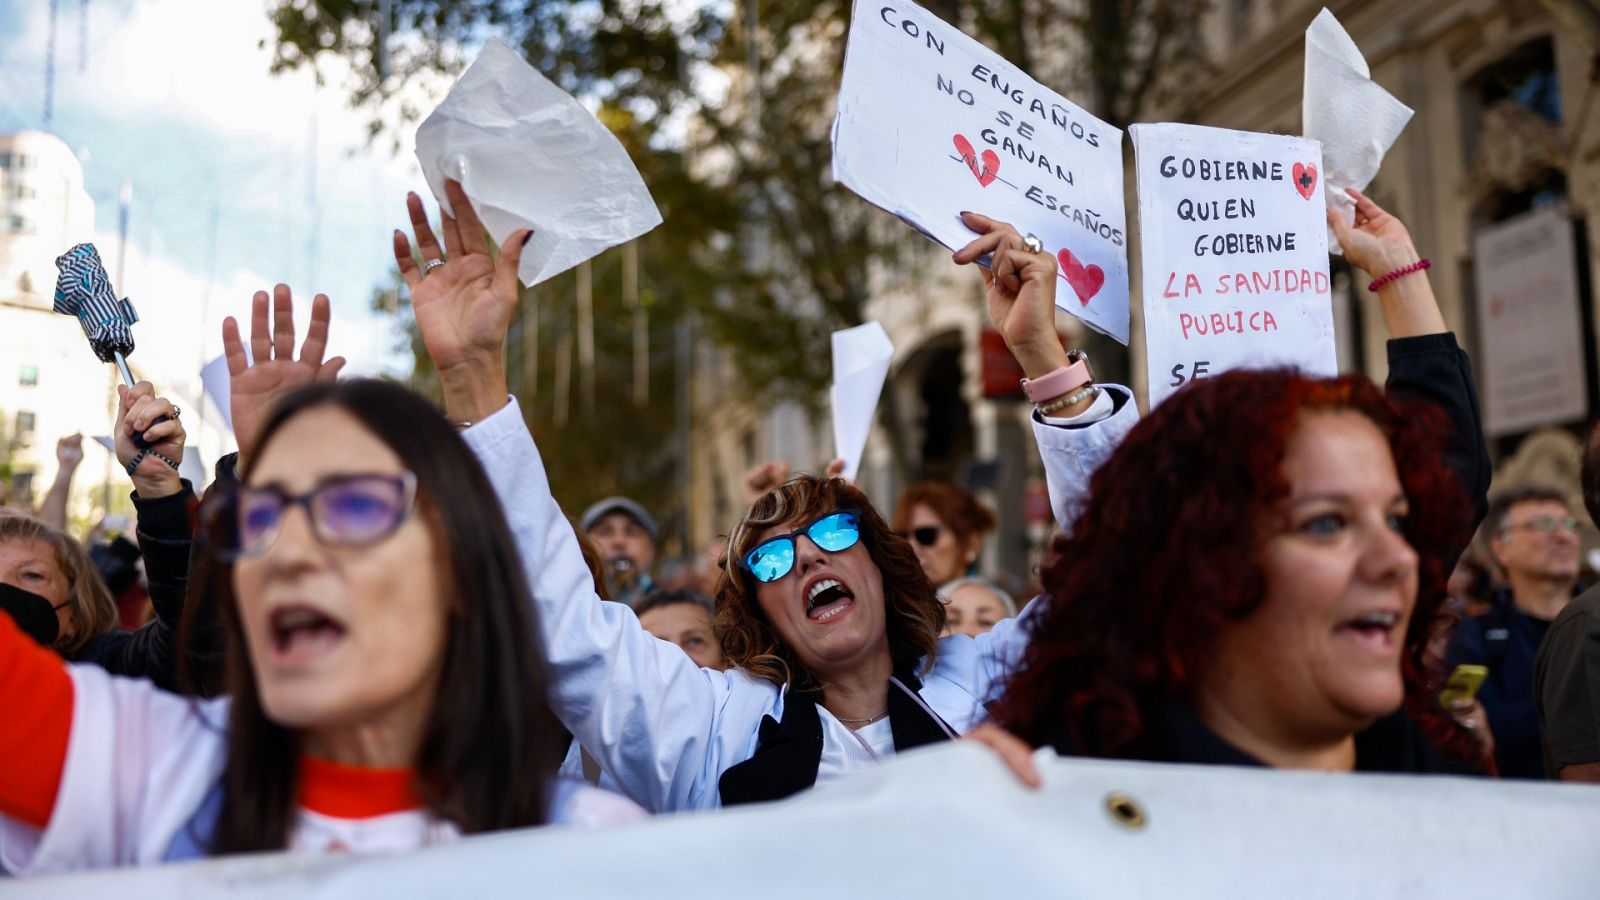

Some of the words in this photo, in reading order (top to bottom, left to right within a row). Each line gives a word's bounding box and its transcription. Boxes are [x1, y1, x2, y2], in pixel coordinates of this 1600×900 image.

[880, 6, 945, 56] CON
[971, 64, 1100, 148] ENGAÑOS
[936, 73, 975, 106] NO
[995, 110, 1035, 141] SE
[980, 128, 1074, 187] GANAN
[1159, 155, 1284, 182] GOBIERNE
[1024, 185, 1125, 247] ESCAÑOS
[1176, 197, 1256, 222] QUIEN
[1194, 232, 1297, 257] GOBIERNE
[1163, 271, 1202, 299] LA
[1215, 269, 1329, 295] SANIDAD
[1179, 310, 1278, 340] PUBLICA
[1170, 360, 1211, 388] SE
